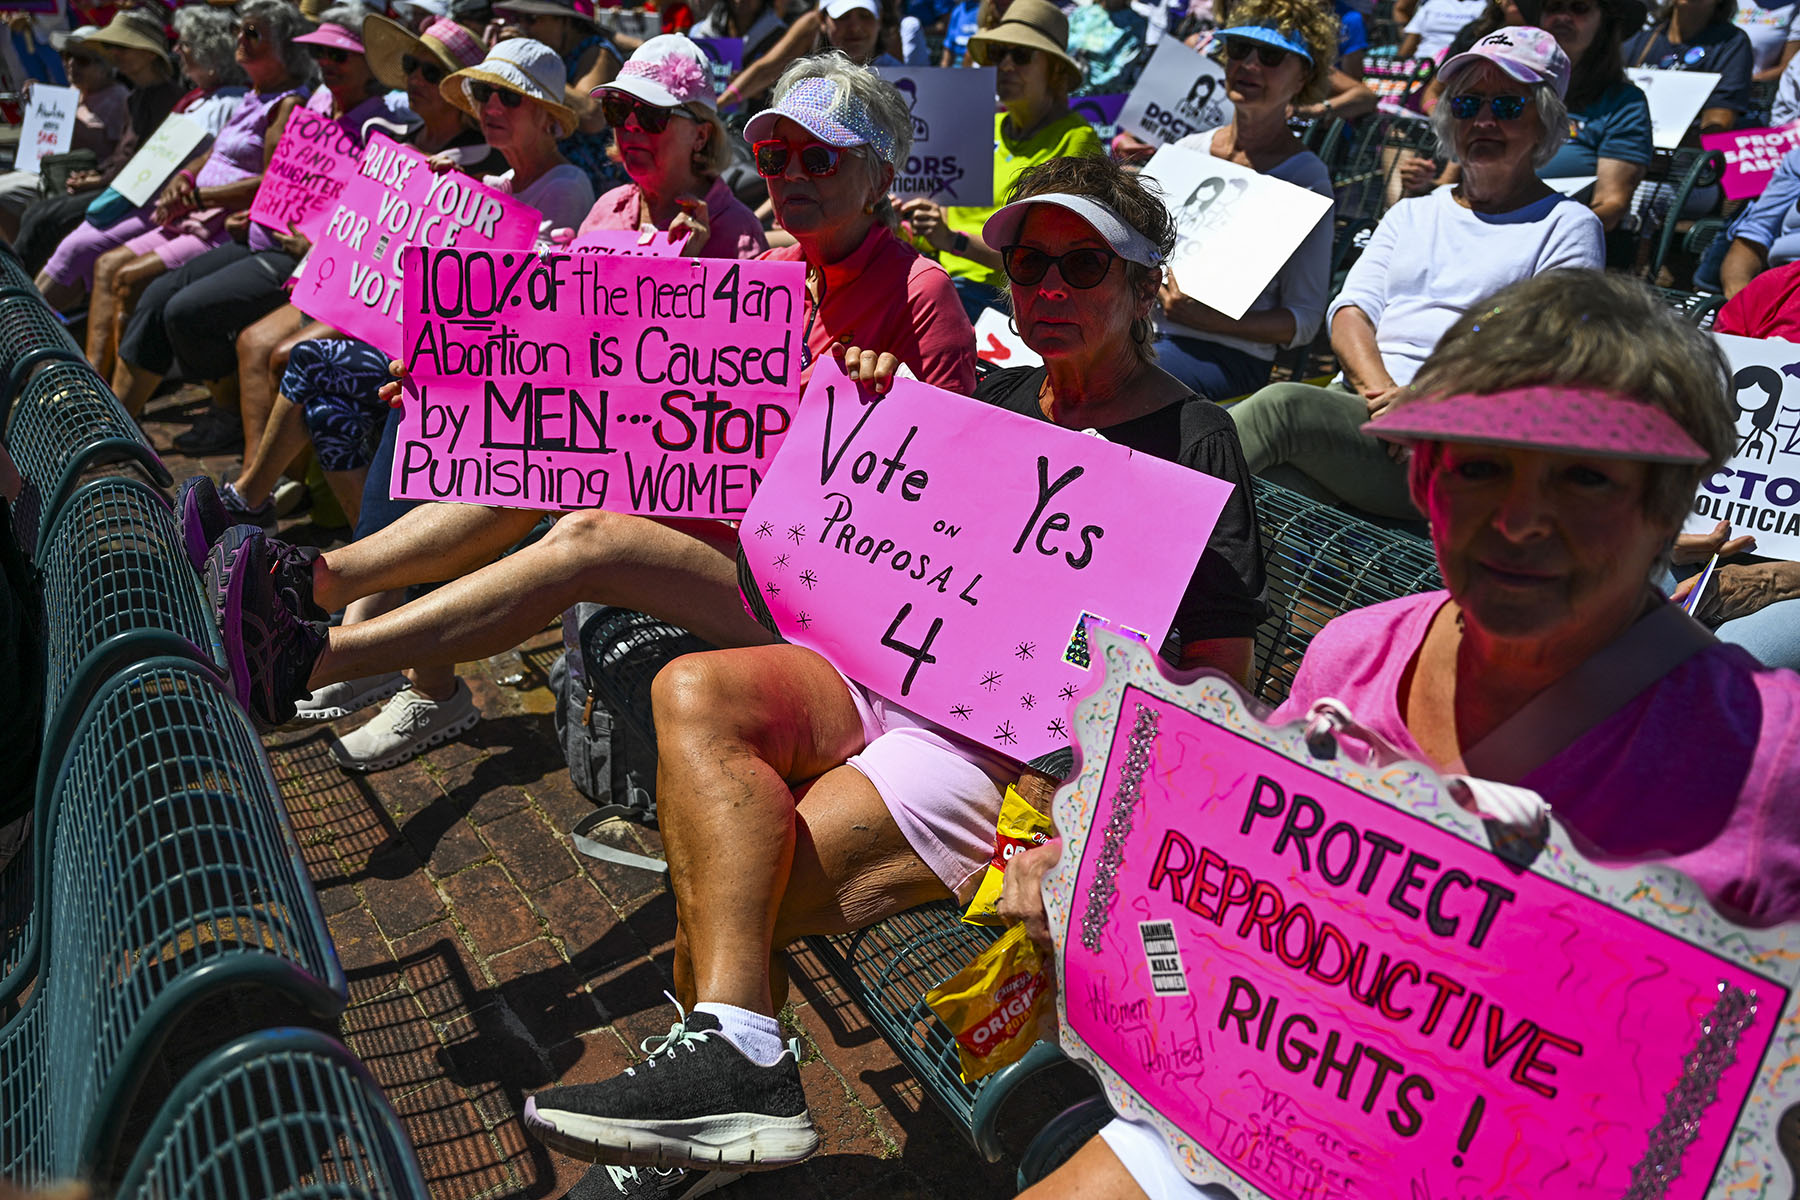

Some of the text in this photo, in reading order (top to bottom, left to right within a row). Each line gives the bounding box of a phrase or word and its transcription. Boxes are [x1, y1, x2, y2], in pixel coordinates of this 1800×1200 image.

[295, 146, 336, 174] AND
[361, 143, 504, 240] RAISE YOUR
[326, 204, 370, 251] FOR
[376, 191, 461, 247] VOICE
[349, 261, 403, 324] VOT
[572, 261, 628, 317] the
[637, 267, 706, 318] need
[713, 263, 740, 323] 4
[742, 280, 792, 323] an
[408, 320, 791, 387] Abortion is Caused
[421, 385, 470, 454] by
[400, 440, 609, 509] Punishing
[821, 385, 1105, 570] Vote Yes
[818, 492, 984, 606] PROPOSAL
[880, 602, 944, 696] 4
[1240, 775, 1515, 949] PROTECT
[1149, 829, 1583, 1099] REPRODUCTIVE
[1151, 959, 1178, 972] KILLS
[1085, 976, 1149, 1024] Women
[1137, 1031, 1204, 1073] United
[1218, 976, 1435, 1138] RIGHTS
[1262, 1088, 1362, 1165] We are
